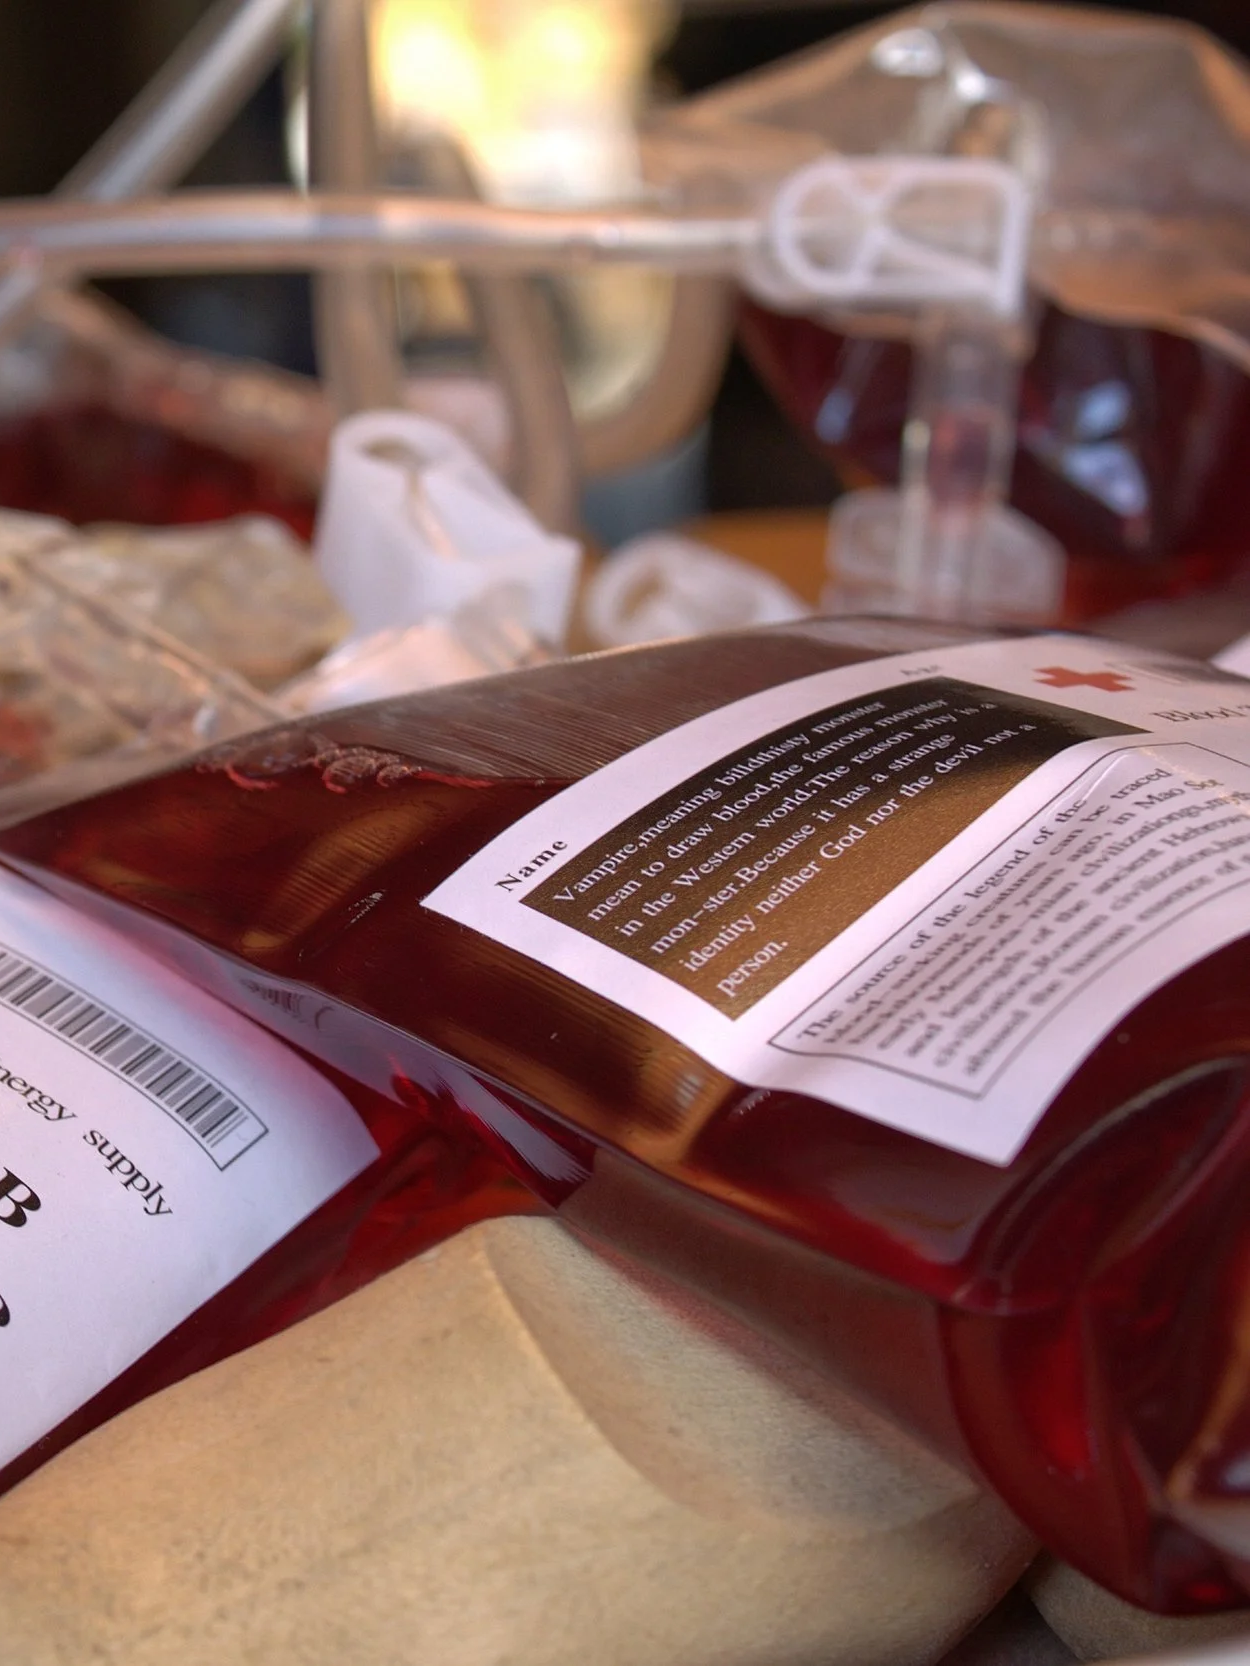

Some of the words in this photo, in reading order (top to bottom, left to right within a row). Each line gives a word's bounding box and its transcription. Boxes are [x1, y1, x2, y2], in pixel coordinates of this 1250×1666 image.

[811, 701, 886, 735] monster
[1151, 706, 1248, 722] Blood
[587, 879, 642, 922] mean
[641, 860, 665, 879] to
[667, 822, 715, 859] draw
[802, 726, 874, 763] famous
[875, 699, 949, 728] monster
[615, 918, 644, 937] in
[642, 891, 677, 917] the
[672, 831, 756, 889] Western
[850, 730, 914, 764] reason
[913, 712, 958, 732] why
[954, 706, 980, 716] is
[980, 702, 997, 710] a
[811, 808, 836, 824] it
[830, 783, 871, 809] has
[871, 772, 890, 784] a
[888, 733, 956, 773] strange
[1049, 829, 1085, 855] can
[1080, 804, 1110, 823] be
[1111, 768, 1173, 799] traced
[1108, 812, 1136, 825] in
[1133, 788, 1186, 809] Mao
[494, 840, 569, 892] Name
[679, 913, 757, 973] identity
[755, 860, 822, 915] neither
[819, 824, 867, 860] God
[865, 797, 902, 826] nor
[899, 773, 935, 798] the
[934, 743, 985, 775] devil
[983, 728, 1019, 746] not
[1018, 723, 1038, 732] a
[797, 1009, 843, 1038] The
[845, 954, 908, 1004] source
[910, 930, 932, 950] of
[933, 904, 967, 928] the
[964, 849, 1030, 899] legend
[1033, 826, 1054, 845] of
[1055, 800, 1087, 823] the
[716, 937, 789, 998] person.
[82, 1129, 172, 1218] supply
